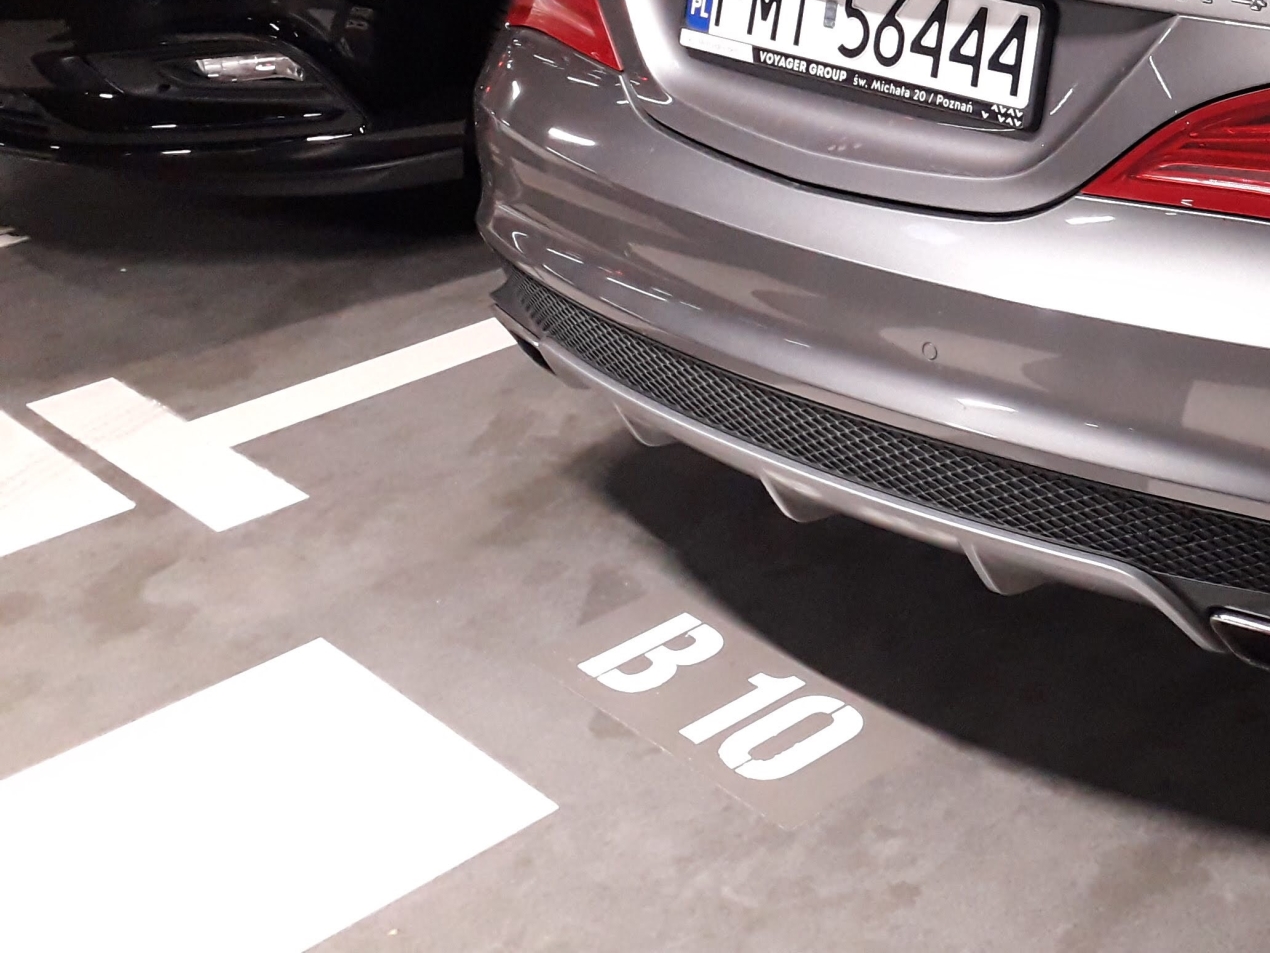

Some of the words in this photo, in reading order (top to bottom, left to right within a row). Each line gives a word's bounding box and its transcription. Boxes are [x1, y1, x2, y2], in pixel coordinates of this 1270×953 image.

[759, 50, 807, 73] VOYAGER
[808, 62, 847, 82] GROUP
[852, 73, 868, 88] św.
[870, 78, 911, 98] Michała
[912, 89, 927, 102] 20
[935, 94, 974, 114] Poznań
[577, 611, 725, 693] B
[678, 671, 864, 781] 10
